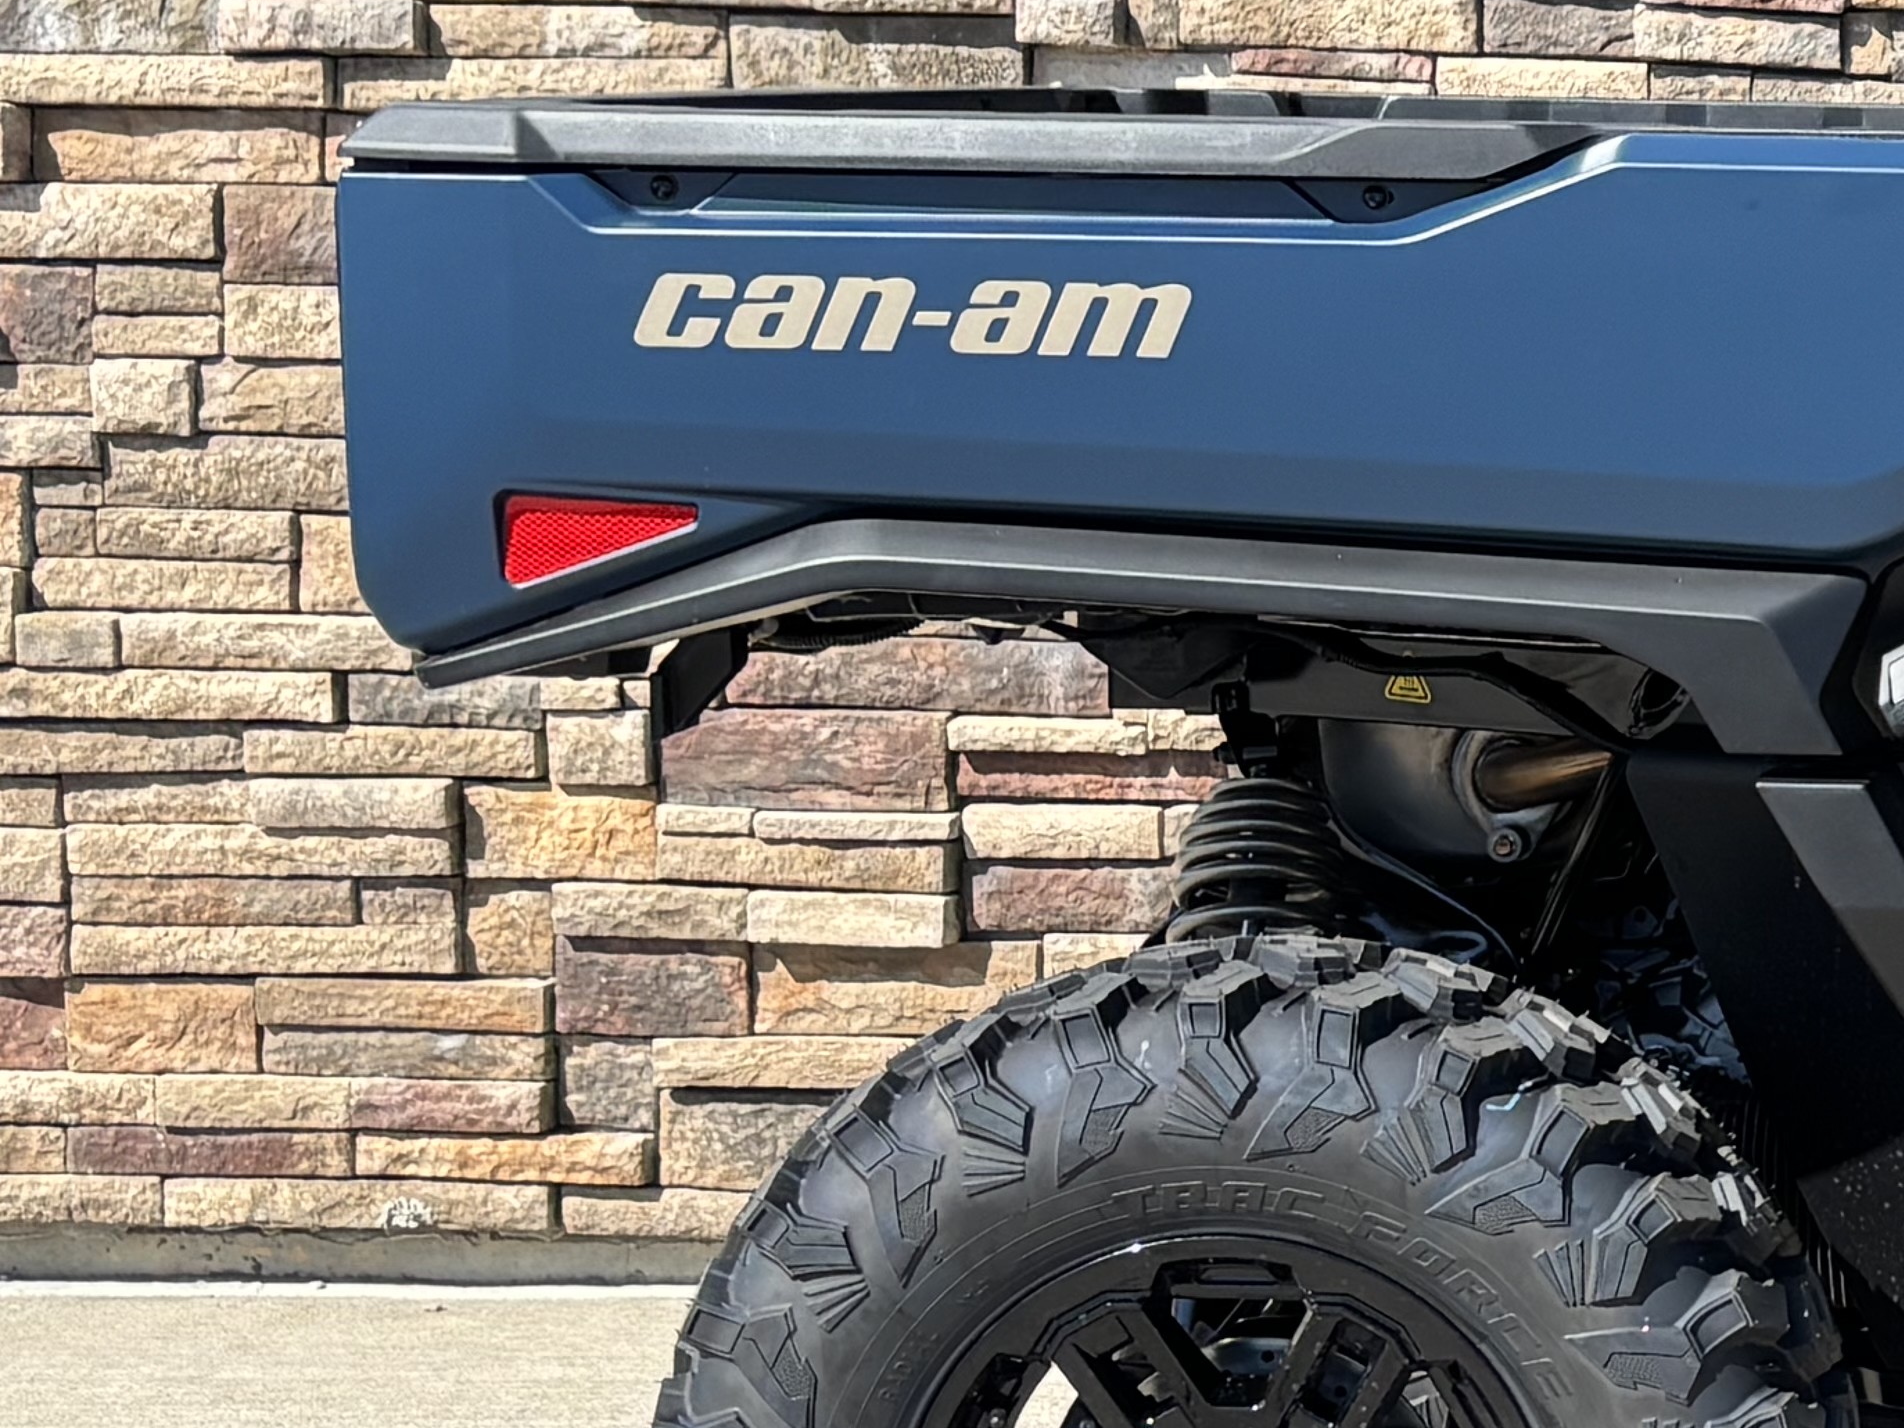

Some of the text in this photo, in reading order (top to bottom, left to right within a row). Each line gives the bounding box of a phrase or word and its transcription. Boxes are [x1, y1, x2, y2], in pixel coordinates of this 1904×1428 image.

[633, 272, 1192, 359] can-am
[1110, 1180, 1574, 1400] TRAC FORCE
